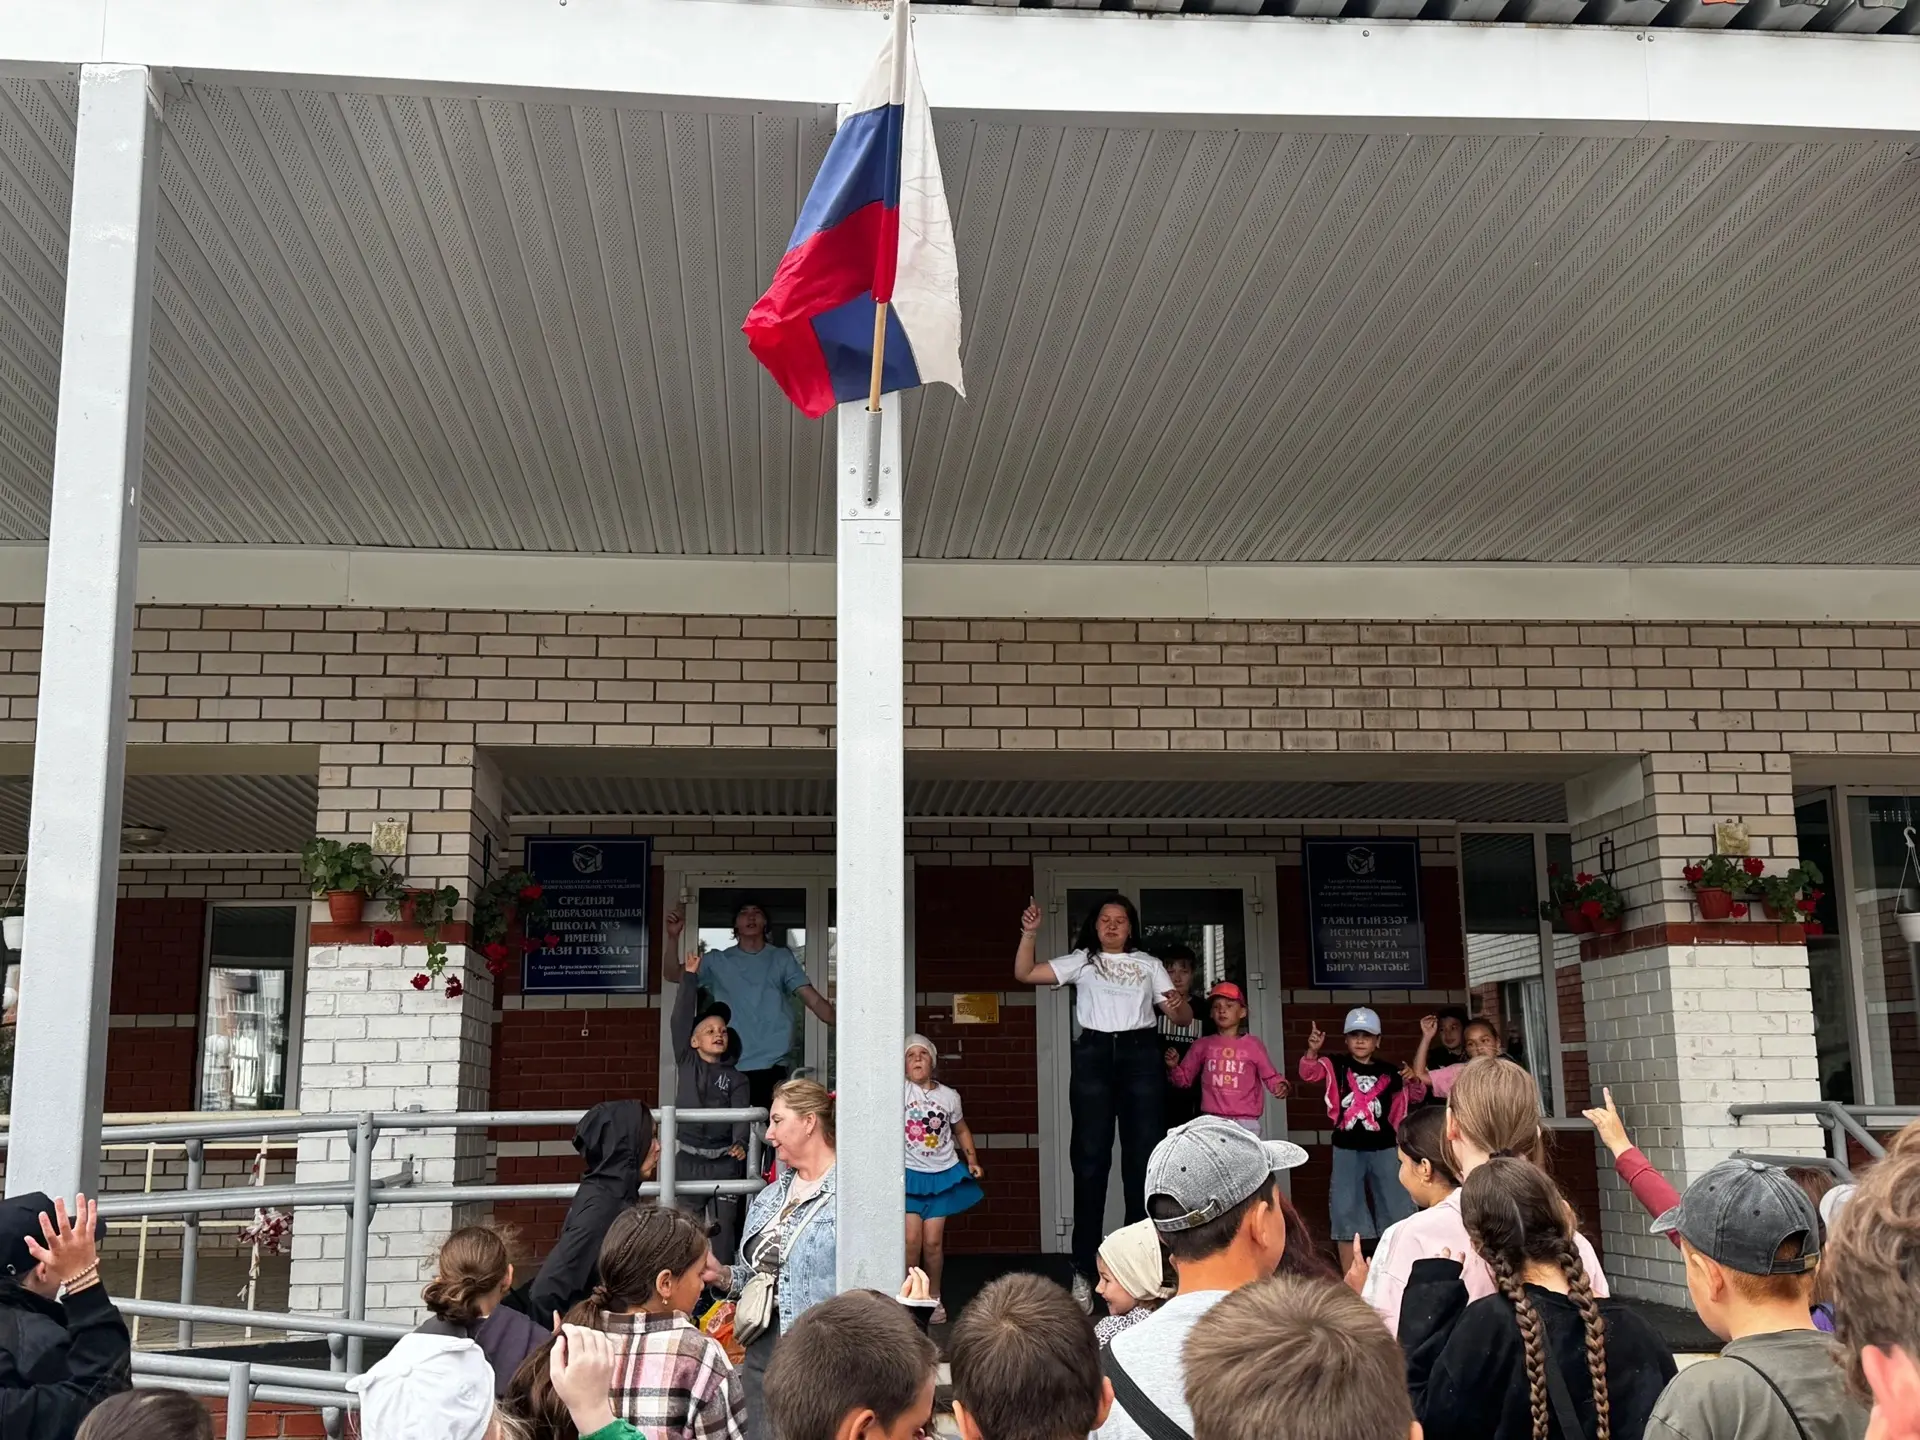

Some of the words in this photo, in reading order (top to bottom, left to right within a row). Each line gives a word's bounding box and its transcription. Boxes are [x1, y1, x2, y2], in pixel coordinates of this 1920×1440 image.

[558, 896, 615, 906] СРЕДНЯЯ
[546, 908, 642, 918] ЩЕОБРАЗОВАТЕЛЬНАЯ
[1321, 916, 1354, 925] ТАЖИ
[551, 921, 597, 931] ШКОЛА
[564, 933, 607, 943] ИМЕНИ
[1370, 940, 1398, 949] УРТА
[540, 946, 572, 955] ТАЗИ
[575, 945, 630, 955] ГИЗЗАТА
[1374, 951, 1410, 960] БЕЛЕМ
[1358, 963, 1411, 972] МӘКТӘБЕ
[1209, 1045, 1248, 1058] TOP
[1207, 1059, 1246, 1074] GIRL
